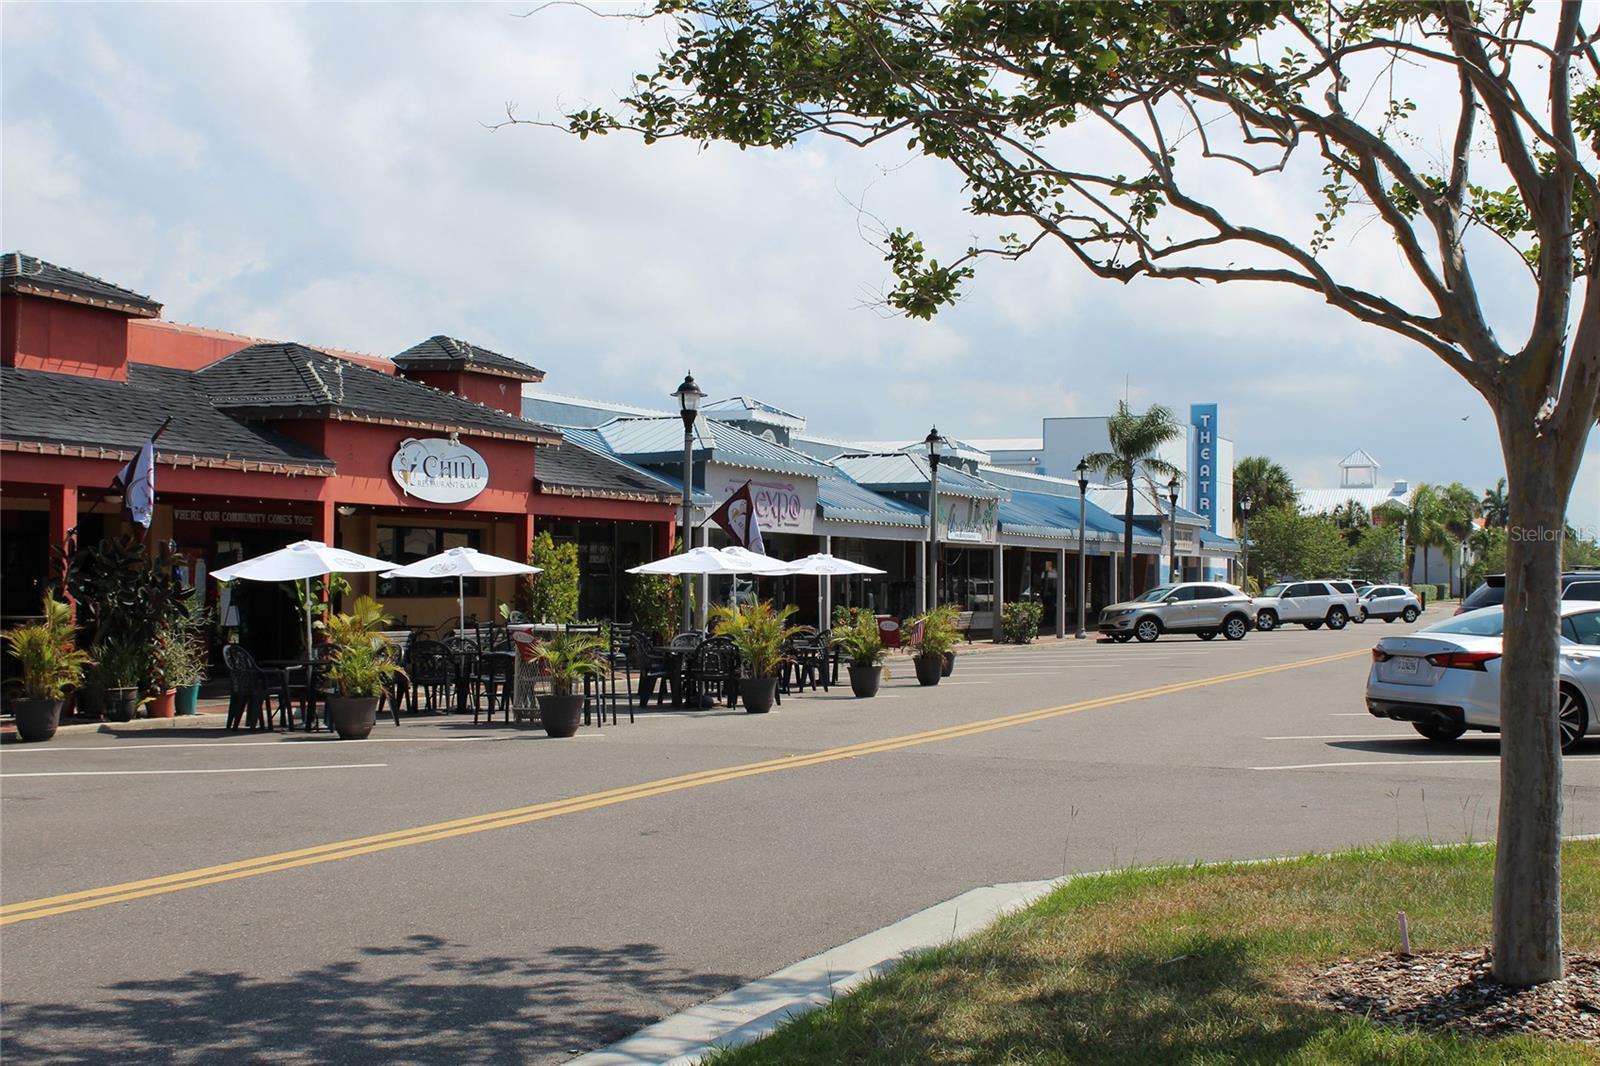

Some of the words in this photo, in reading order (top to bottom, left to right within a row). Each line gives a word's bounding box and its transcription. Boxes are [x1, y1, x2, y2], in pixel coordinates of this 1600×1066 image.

[203, 511, 220, 521] OUR
[221, 511, 265, 523] COMMUNITY
[267, 513, 293, 525] COMES
